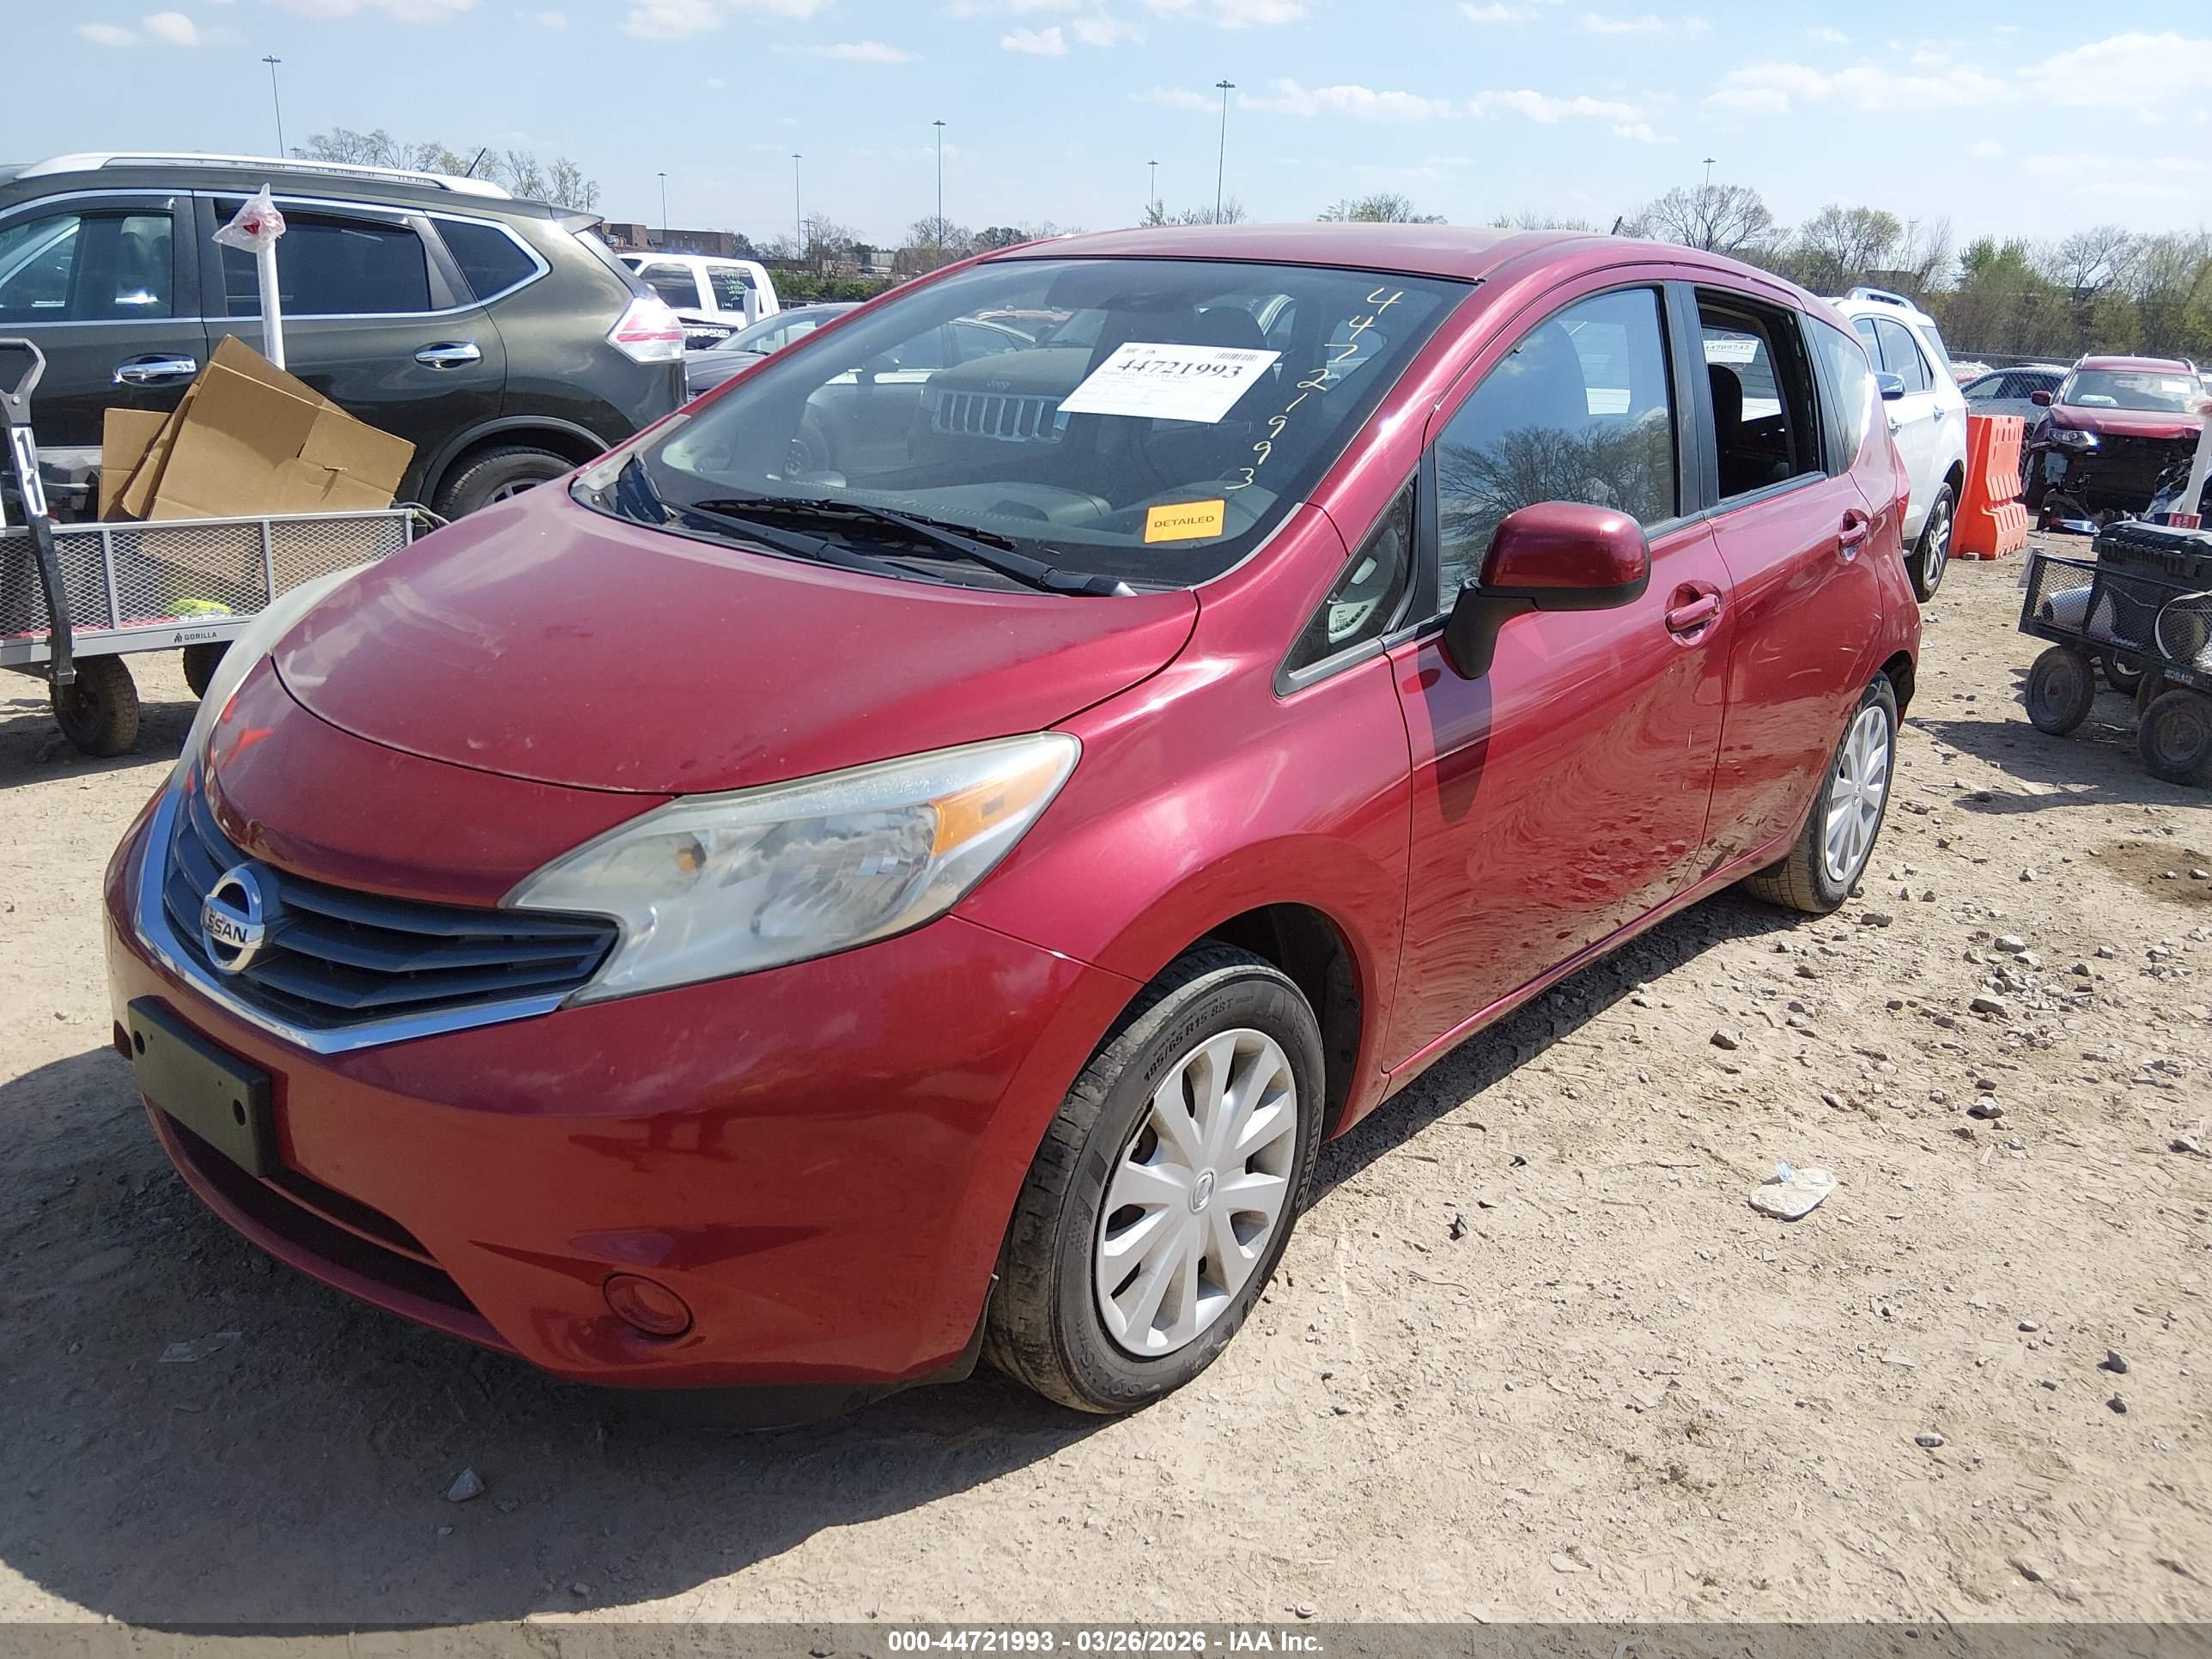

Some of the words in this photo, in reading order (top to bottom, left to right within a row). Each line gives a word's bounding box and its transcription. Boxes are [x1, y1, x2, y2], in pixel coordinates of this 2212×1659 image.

[1117, 359, 1243, 379] 44721993
[1153, 515, 1215, 528] DETAILED
[184, 632, 217, 641] GORILLA
[203, 909, 247, 943] SSAN
[1185, 1012, 1208, 1036] R15
[1296, 1093, 1322, 1209] KUMHO
